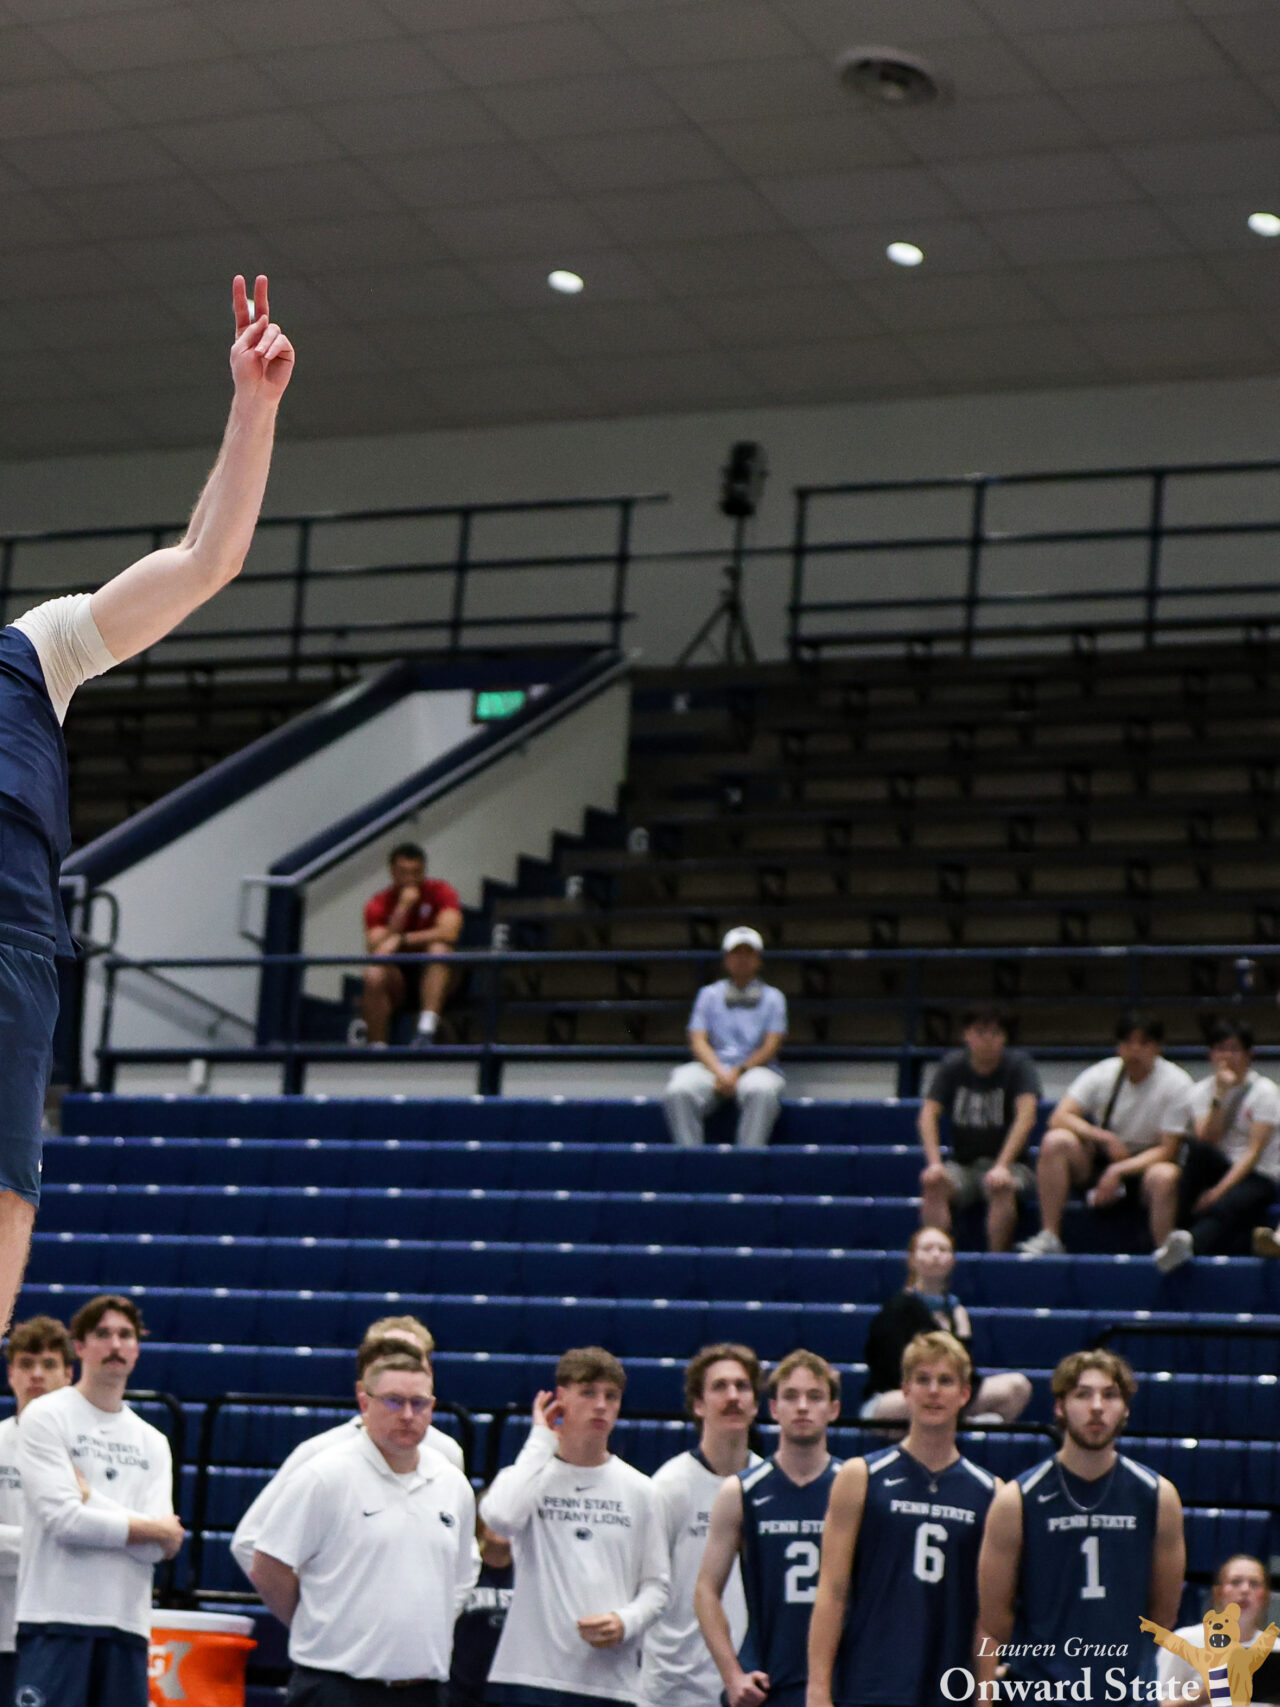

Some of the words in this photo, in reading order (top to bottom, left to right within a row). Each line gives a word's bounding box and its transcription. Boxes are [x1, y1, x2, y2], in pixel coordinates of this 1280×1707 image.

[544, 1496, 581, 1509] PENN
[584, 1499, 623, 1512] STATE
[890, 1499, 930, 1515] PENN
[931, 1504, 976, 1524] STATE
[592, 1512, 631, 1528] LIONS
[758, 1520, 799, 1534] PENN
[1048, 1515, 1088, 1532] PENN
[1091, 1514, 1137, 1530] STATE
[913, 1522, 949, 1583] 6
[785, 1541, 820, 1603] 2
[1080, 1536, 1107, 1599] 1
